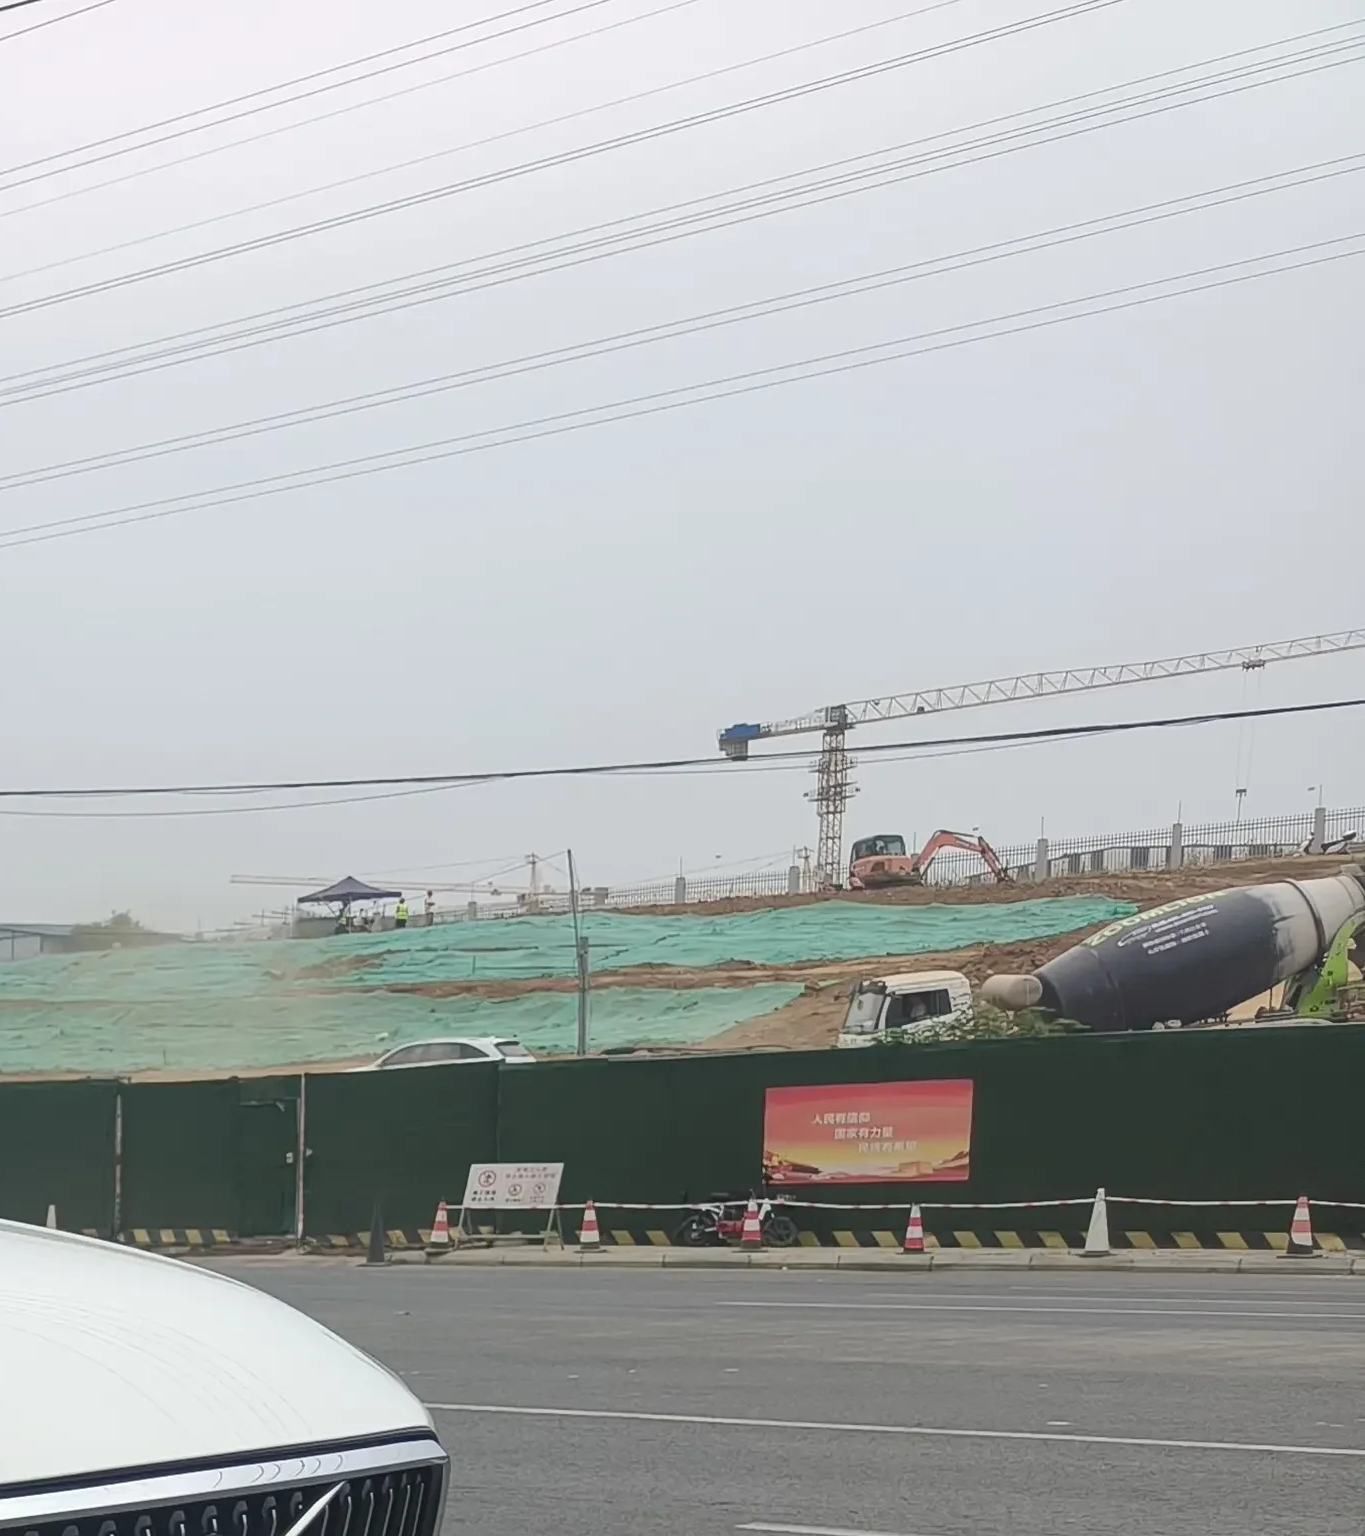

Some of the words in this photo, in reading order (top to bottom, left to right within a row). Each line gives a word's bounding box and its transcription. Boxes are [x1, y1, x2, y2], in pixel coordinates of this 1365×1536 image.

[811, 1111, 871, 1125] 人民有信仰
[834, 1125, 894, 1140] 国家有力量
